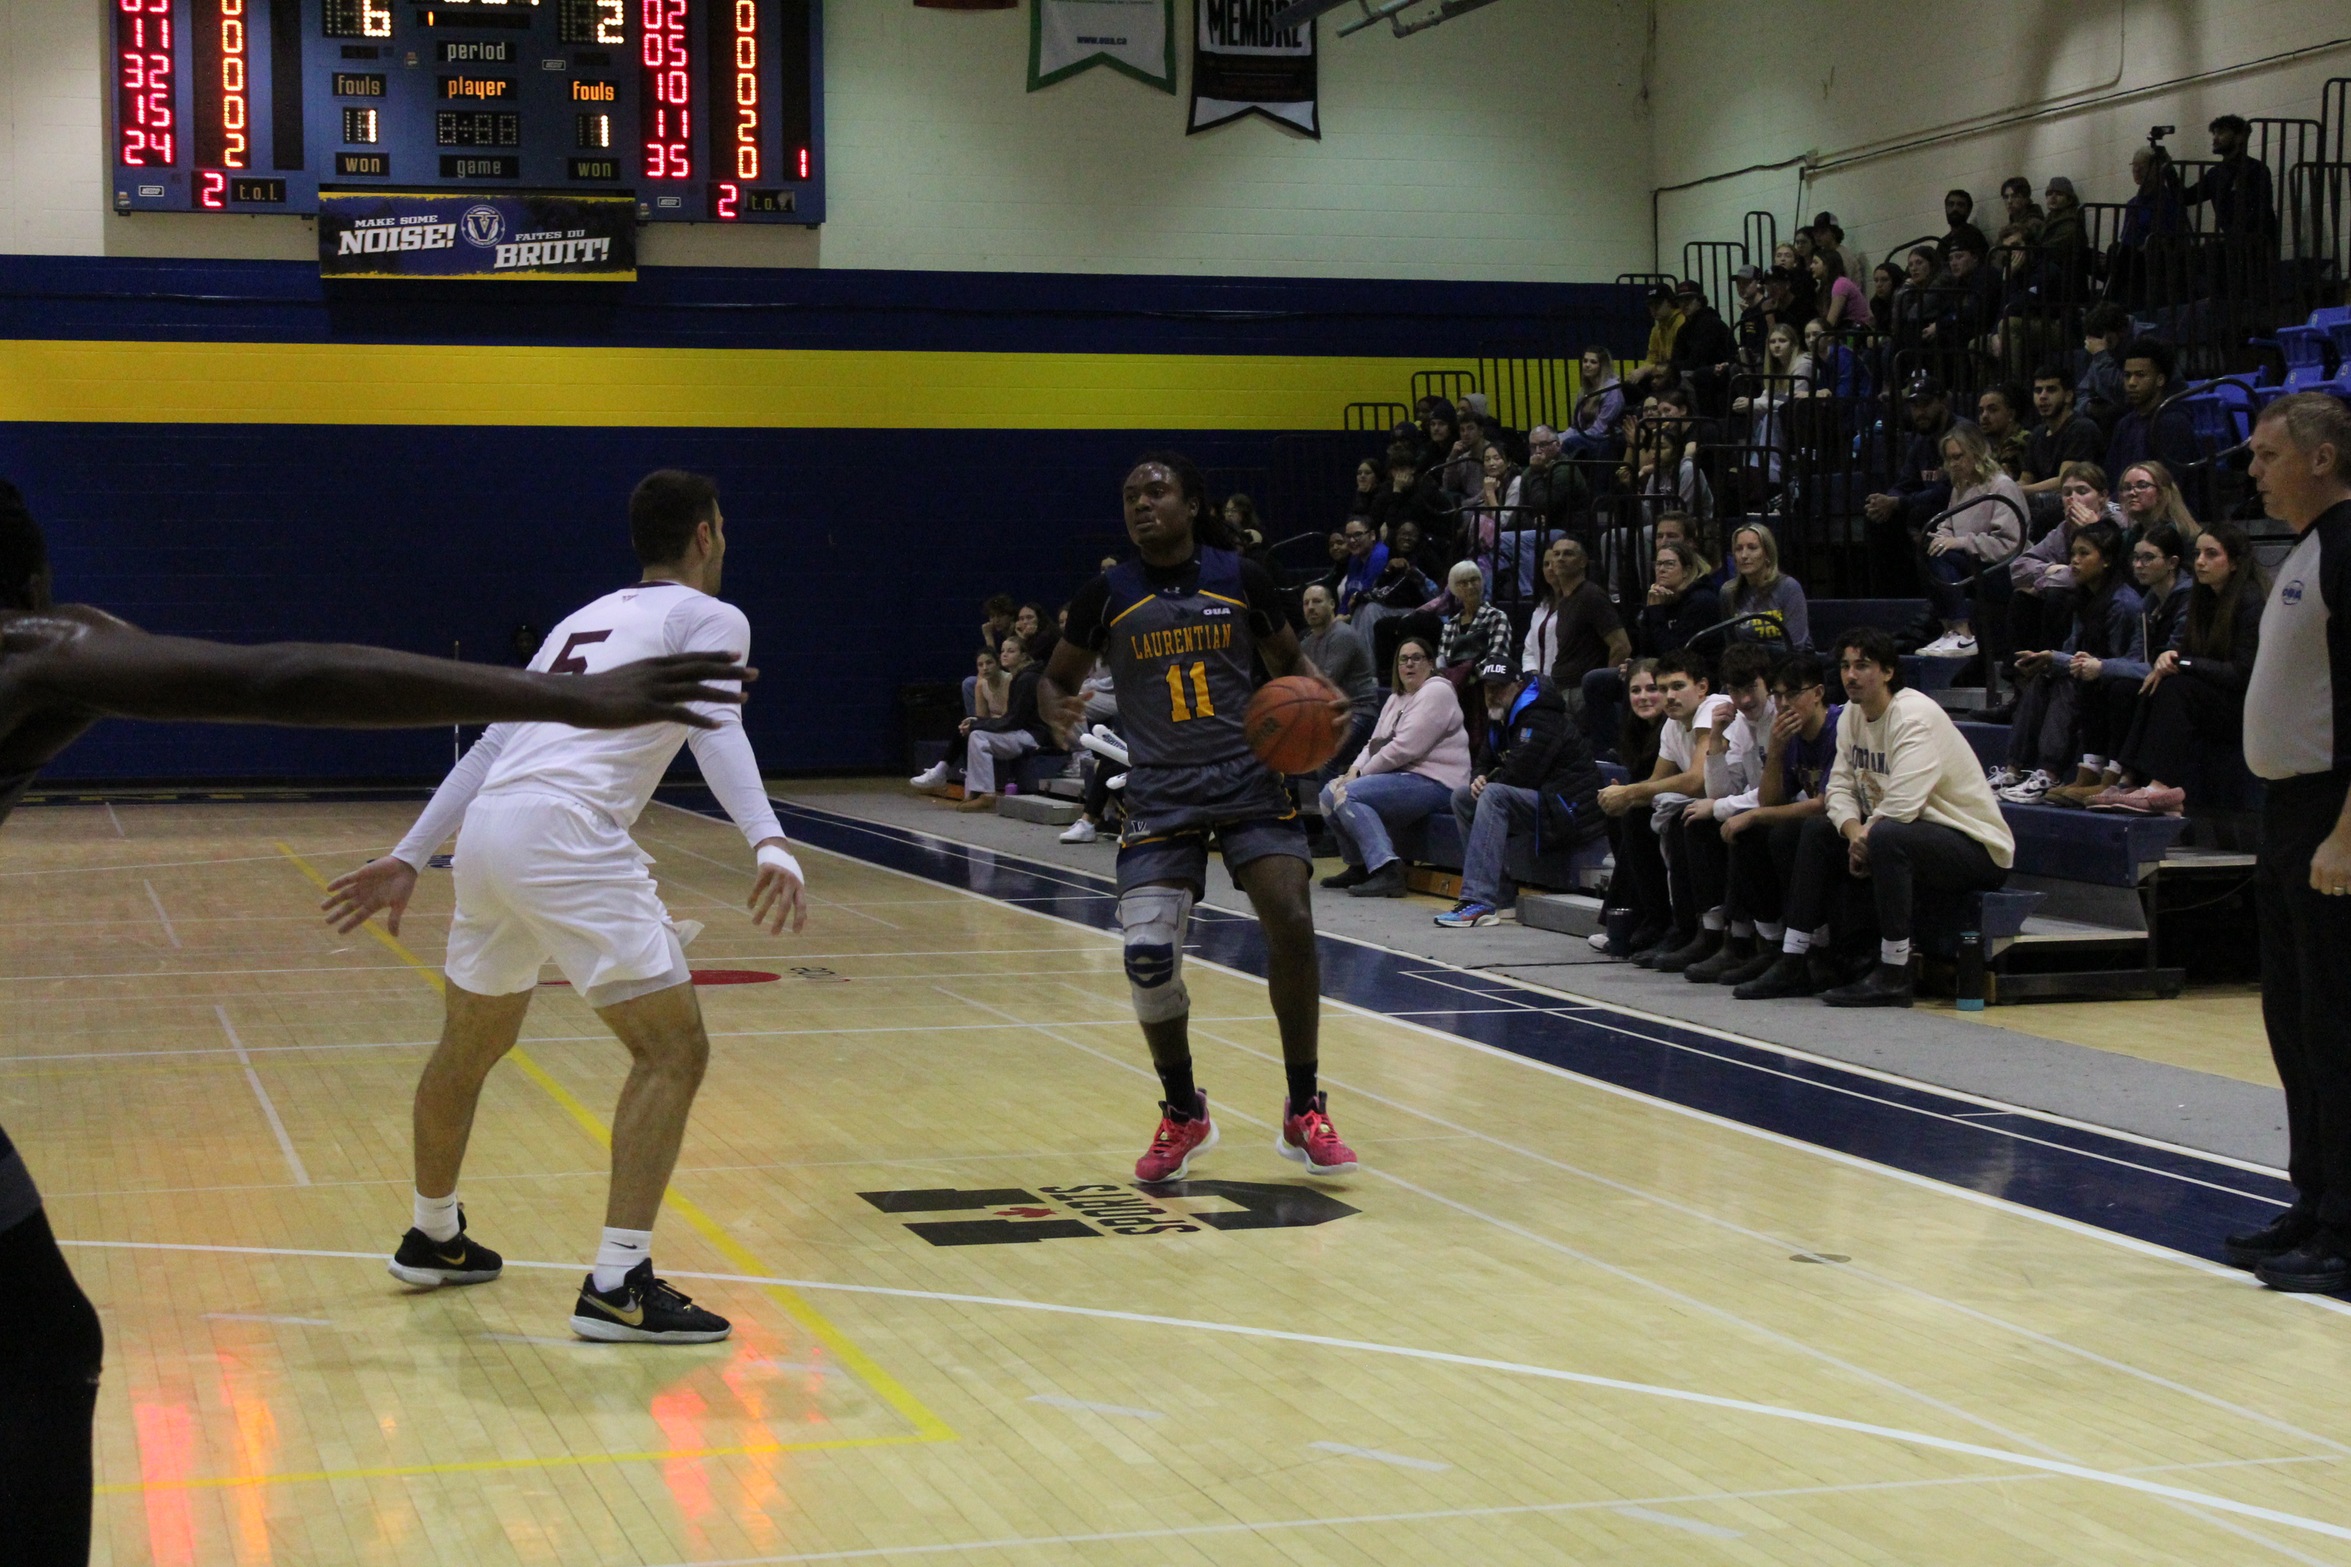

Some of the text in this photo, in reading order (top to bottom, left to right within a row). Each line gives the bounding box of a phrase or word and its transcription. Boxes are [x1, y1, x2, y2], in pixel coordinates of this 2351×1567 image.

[597, 0, 624, 43] 2
[643, 0, 687, 30] 02
[736, 0, 755, 32] 0
[134, 17, 170, 49] 11
[222, 19, 243, 53] 0
[447, 42, 506, 61] period
[644, 33, 687, 67] 05
[736, 36, 756, 69] 0
[124, 53, 170, 89] 32
[222, 57, 243, 92] 0
[337, 76, 380, 96] fouls
[448, 76, 506, 99] player
[656, 71, 688, 104] 10
[573, 81, 615, 101] fouls
[736, 73, 756, 105] 0
[134, 93, 172, 127] 15
[223, 95, 244, 129] 0
[657, 109, 689, 138] 11
[737, 109, 757, 142] 2
[124, 130, 172, 165] 24
[224, 133, 245, 168] 2
[647, 143, 690, 178] 35
[737, 146, 758, 179] 0
[800, 149, 808, 178] 1
[345, 157, 380, 173] won
[456, 159, 501, 178] game
[577, 161, 612, 178] won
[203, 173, 223, 207] 2
[718, 184, 737, 217] 2
[355, 215, 438, 228] MAKE SOME
[515, 229, 586, 241] FAITES DU
[337, 223, 457, 256] NOISE!
[493, 237, 611, 269] BRUIT!
[1203, 607, 1231, 616] OUA
[549, 629, 613, 675] 5
[1131, 623, 1231, 660] LAURENTIAN
[1166, 661, 1215, 722] 11
[1038, 1184, 1201, 1236] SPORTS
